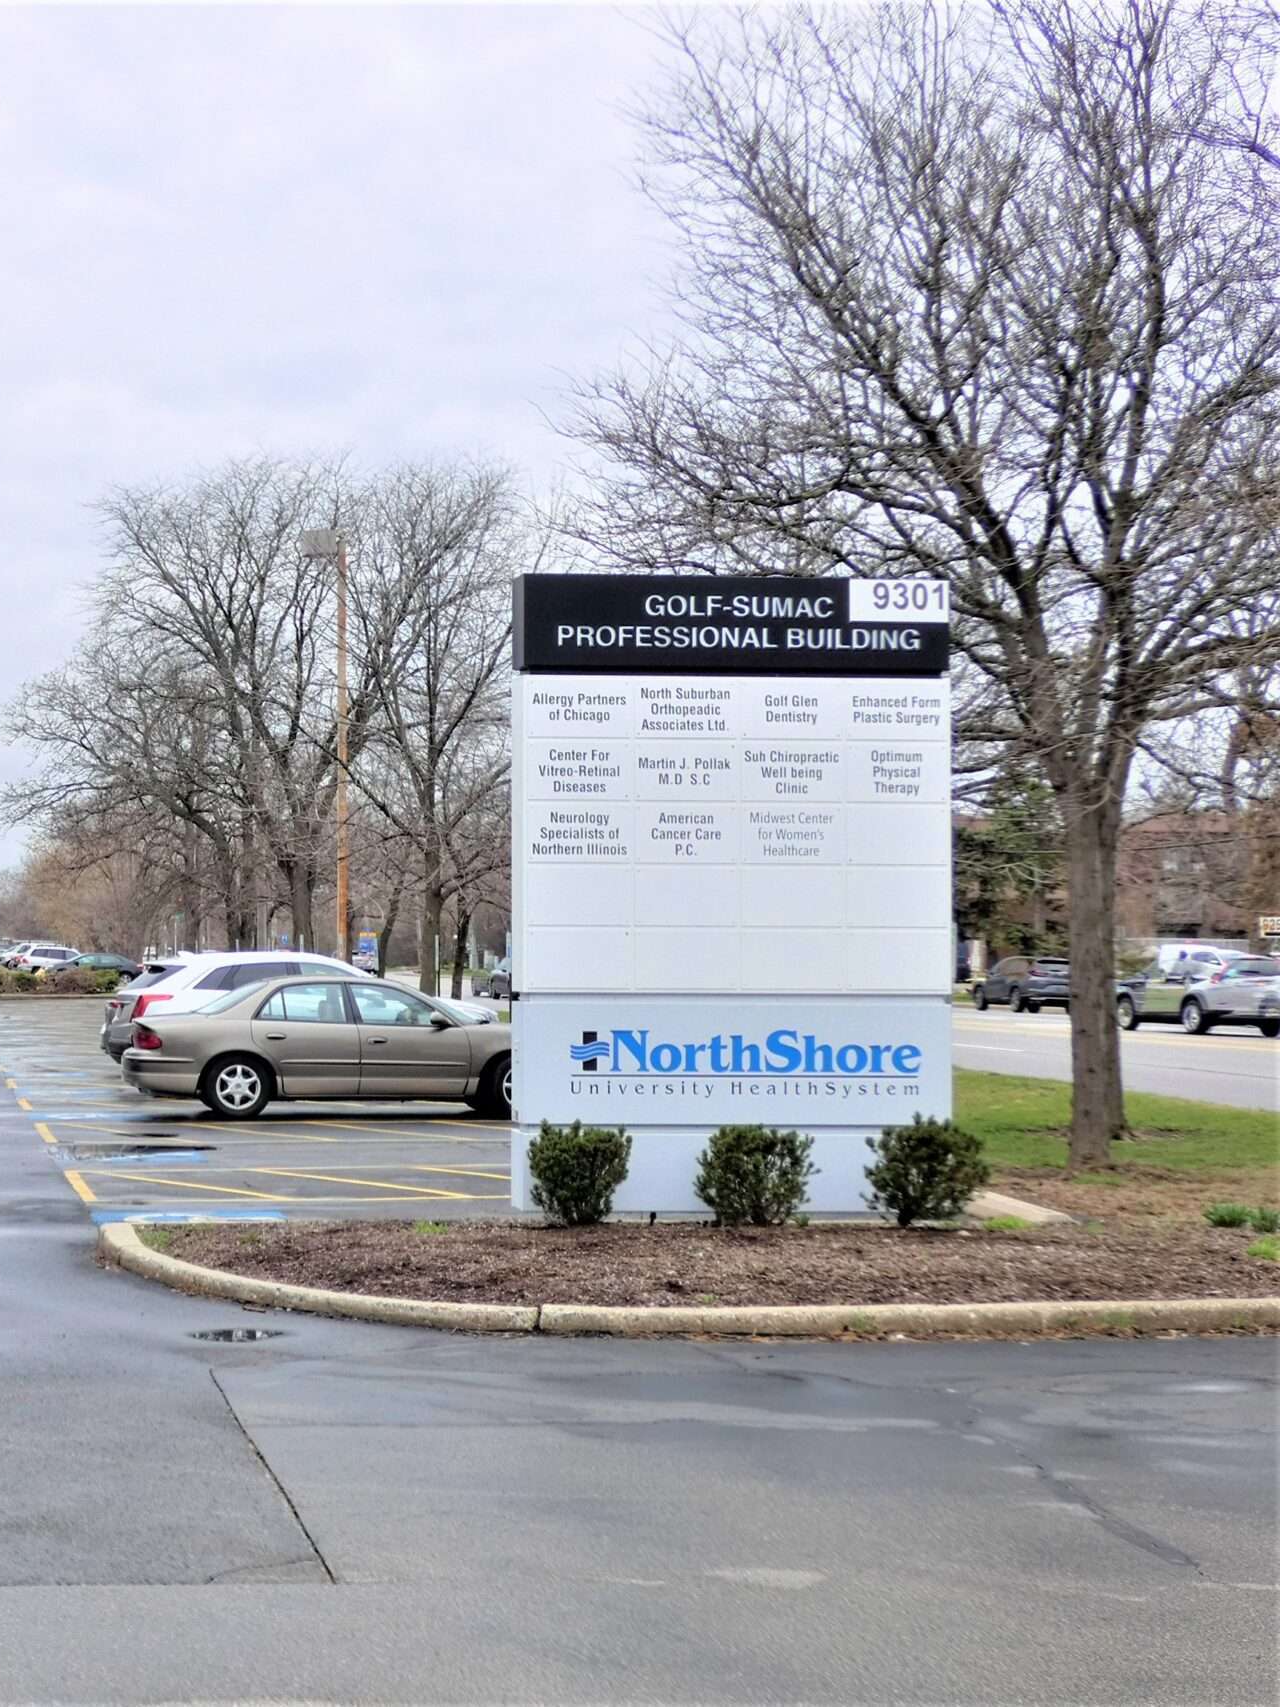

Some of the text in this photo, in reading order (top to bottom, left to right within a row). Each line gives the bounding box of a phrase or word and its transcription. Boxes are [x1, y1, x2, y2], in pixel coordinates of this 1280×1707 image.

[873, 582, 945, 610] 9301
[645, 595, 832, 617] GOLF-SUMAC
[558, 626, 920, 649] PROFESSIONAL BUILDING
[533, 693, 626, 707] Allergy Partners
[641, 688, 730, 699] North Suburban
[765, 695, 818, 707] Golf Glen
[853, 696, 940, 708] Enhanced Form
[549, 709, 610, 723] of Chicago
[651, 703, 720, 717] Orthopeadic
[641, 719, 728, 731] Associates Ltd.
[766, 711, 817, 725] Dentistry
[853, 712, 940, 726] Plastic Surgery
[550, 749, 609, 761] Center For
[745, 751, 839, 765] Suh Chiropractic
[871, 750, 922, 764] Optimum
[539, 765, 620, 776] Vitreo-Retinal
[639, 758, 675, 769] Martin
[695, 758, 730, 769] Pollak
[761, 767, 822, 781] Well being
[873, 766, 920, 780] Physical
[554, 781, 606, 792] Diseases
[776, 782, 808, 794] Clinic
[874, 781, 919, 796] Therapy
[551, 812, 609, 826] Neurology
[659, 813, 713, 824] American
[750, 812, 832, 824] Midwest Center
[540, 827, 619, 841] Specialists of
[651, 828, 721, 840] Cancer Care
[758, 827, 824, 840] for Women's
[533, 843, 627, 855] Northern Illinois
[675, 844, 696, 856] P.C.
[763, 844, 819, 856] Healthcare
[610, 1030, 921, 1073] NorthShore
[571, 1081, 919, 1098] University HealthSystem
